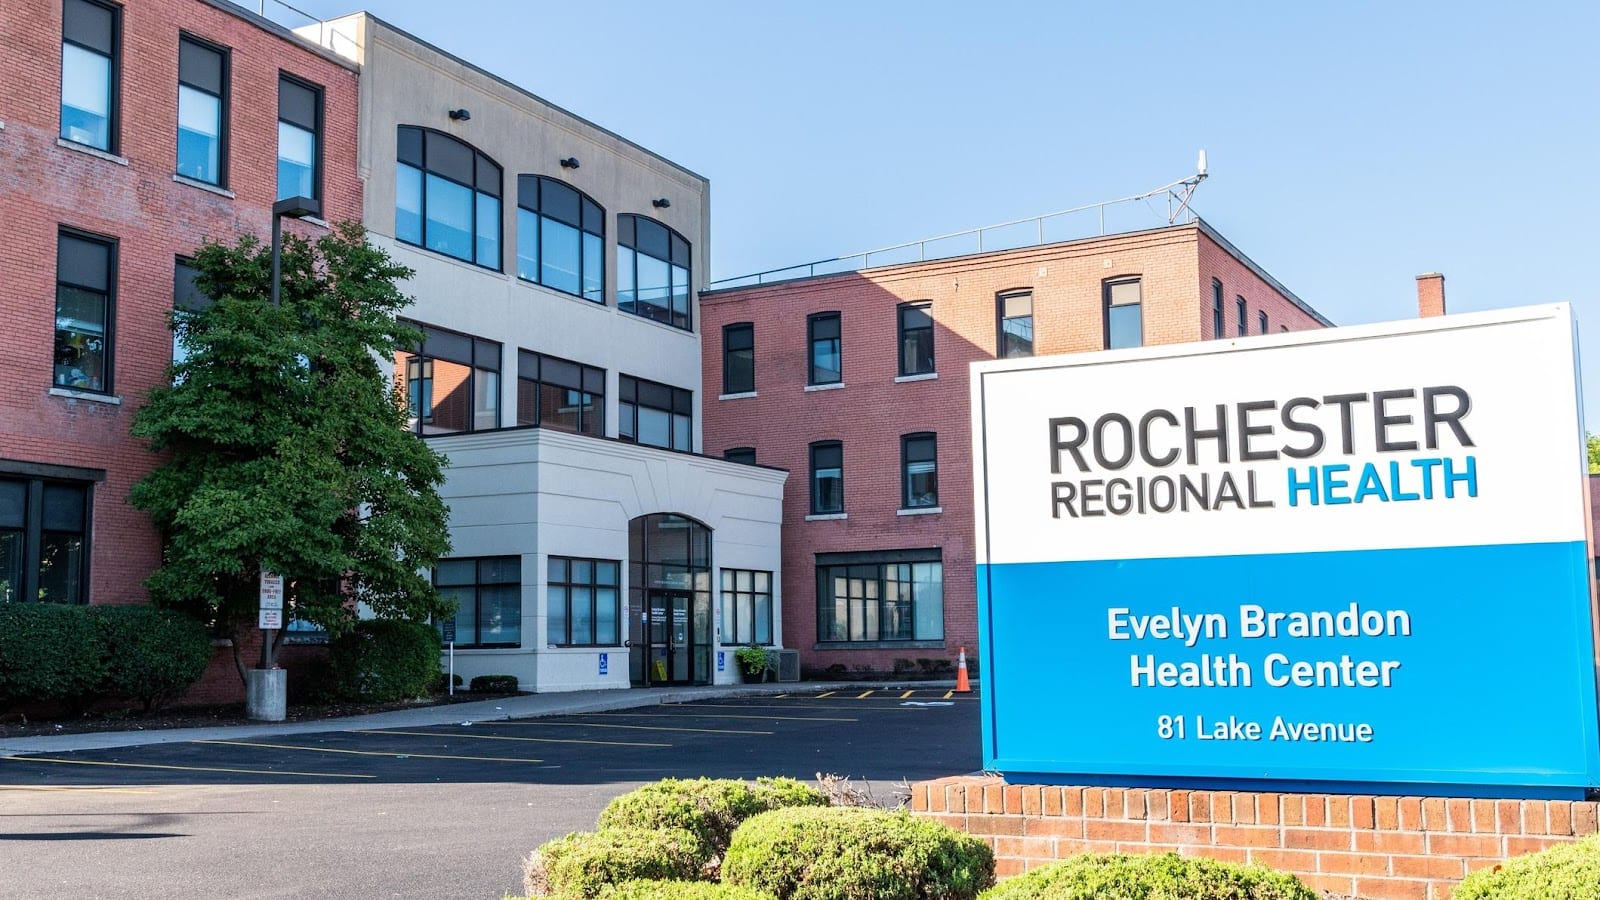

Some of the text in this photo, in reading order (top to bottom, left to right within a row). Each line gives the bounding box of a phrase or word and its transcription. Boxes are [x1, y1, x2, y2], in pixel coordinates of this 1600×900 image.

[1048, 385, 1477, 475] ROCHESTER
[1051, 456, 1478, 519] REGIONAL HEALTH
[1107, 602, 1411, 647] Evelyn Brandon
[1130, 652, 1401, 687] Health Center
[1157, 715, 1374, 742] 81 Lake Avenue
